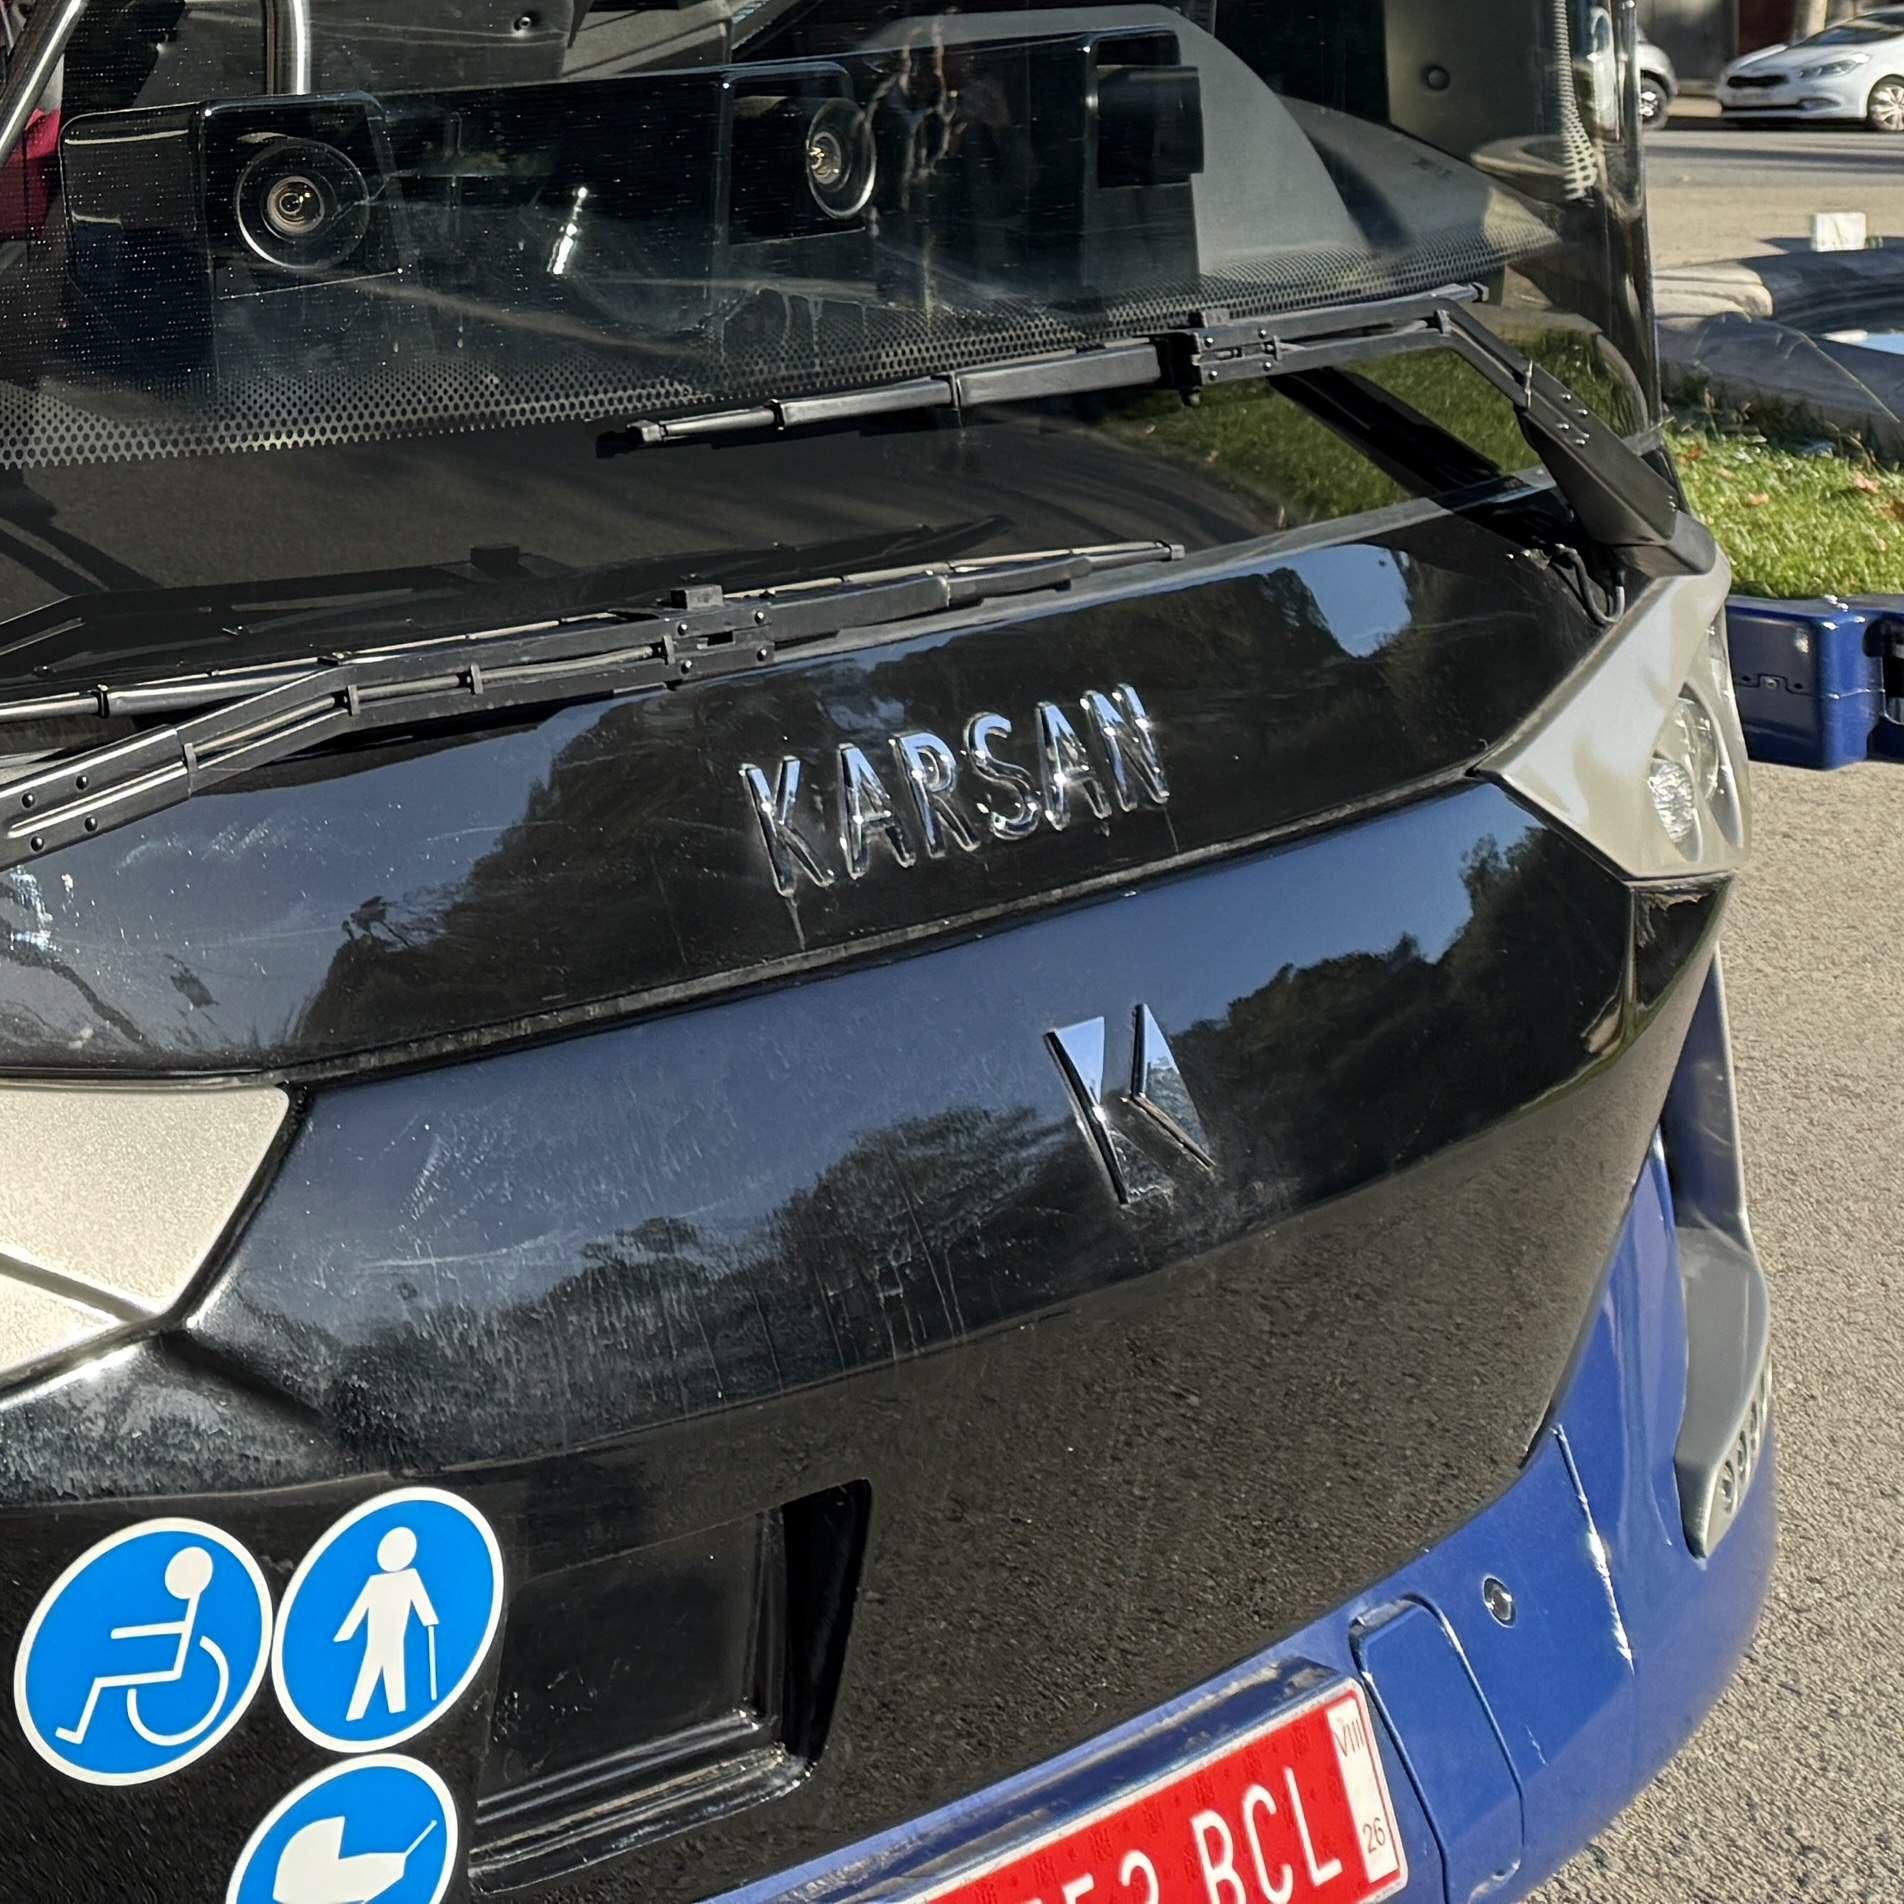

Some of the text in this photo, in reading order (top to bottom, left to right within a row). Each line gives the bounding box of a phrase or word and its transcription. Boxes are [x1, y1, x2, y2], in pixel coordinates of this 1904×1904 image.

[739, 682, 1171, 898] KARSAN
[1190, 1766, 1344, 1904] BCL
[1362, 1816, 1386, 1854] 26
